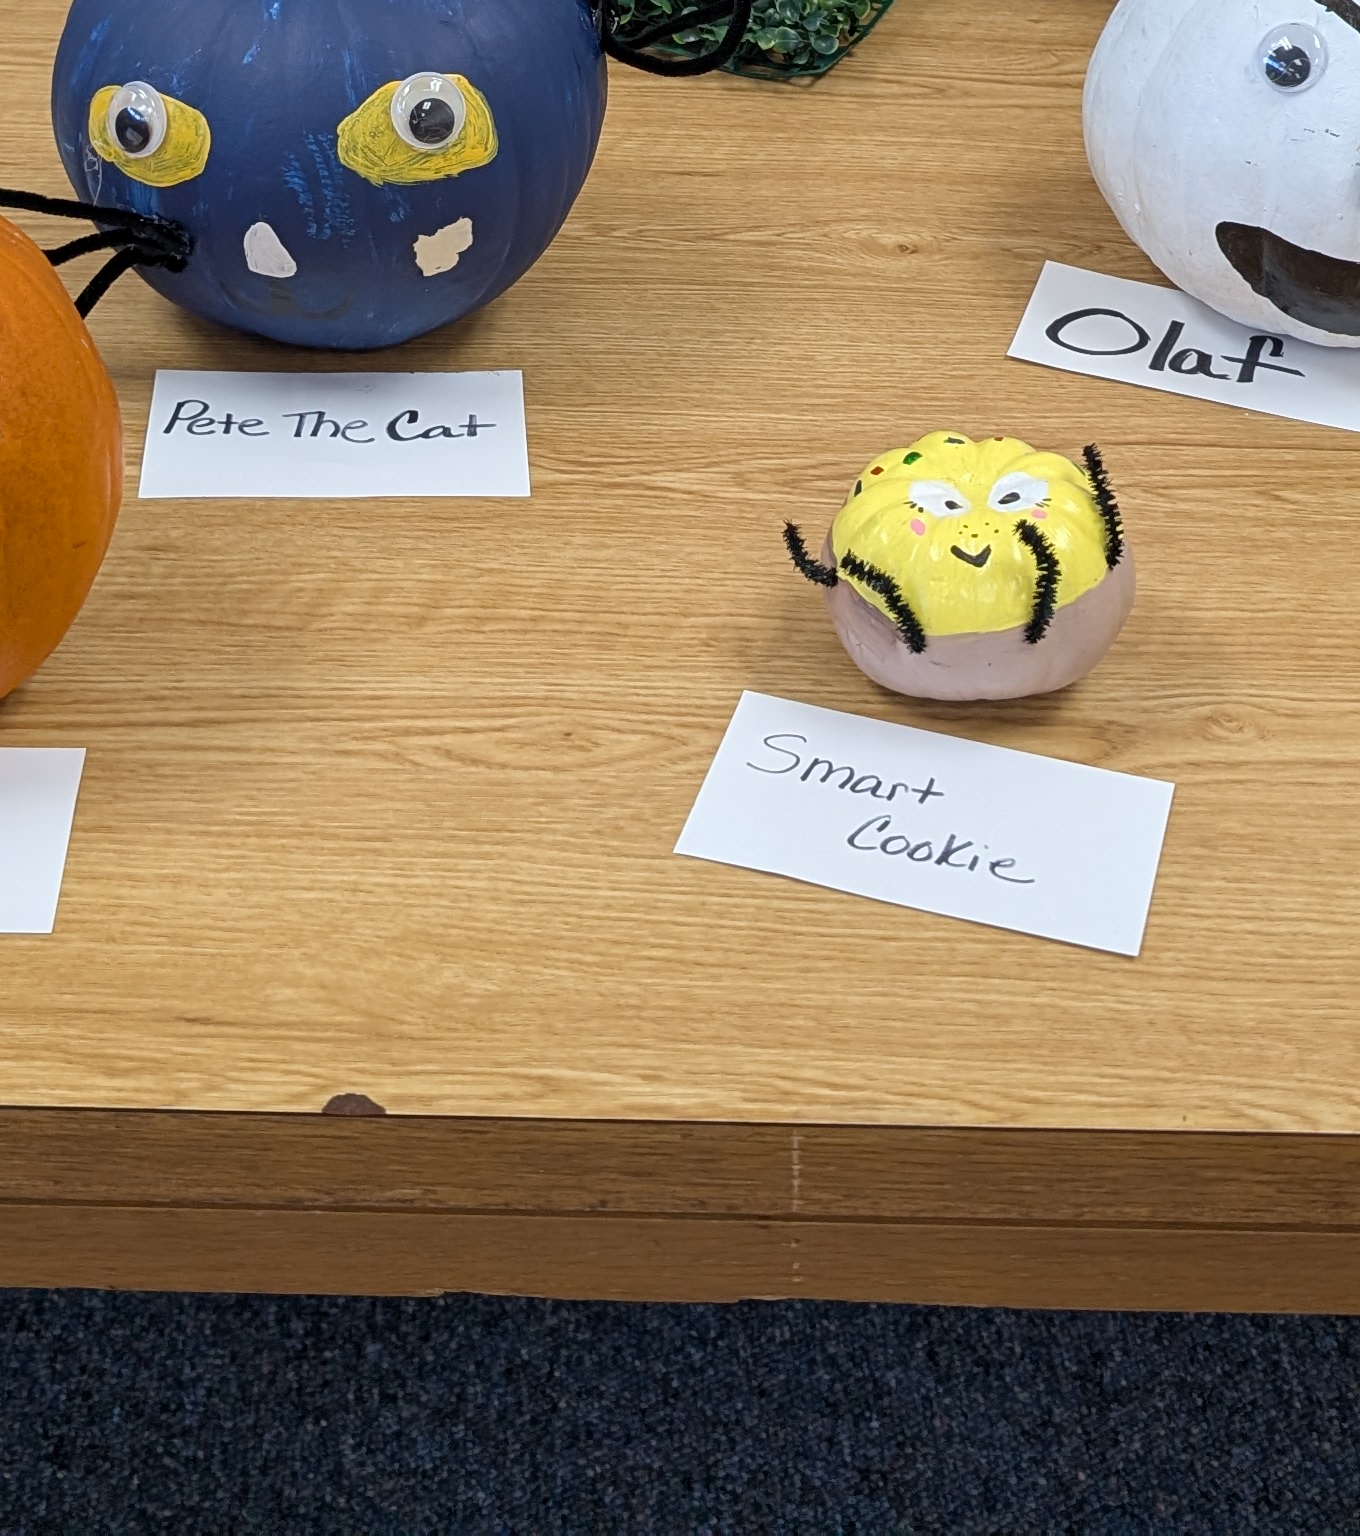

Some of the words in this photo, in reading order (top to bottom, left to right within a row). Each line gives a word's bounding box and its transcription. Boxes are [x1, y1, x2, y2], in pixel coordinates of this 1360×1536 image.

[1045, 307, 1306, 383] Olaf
[163, 399, 270, 438] Pete
[282, 410, 376, 443] The
[385, 409, 497, 442] Cat
[746, 733, 945, 805] Smart
[846, 814, 1035, 885] Cookie
